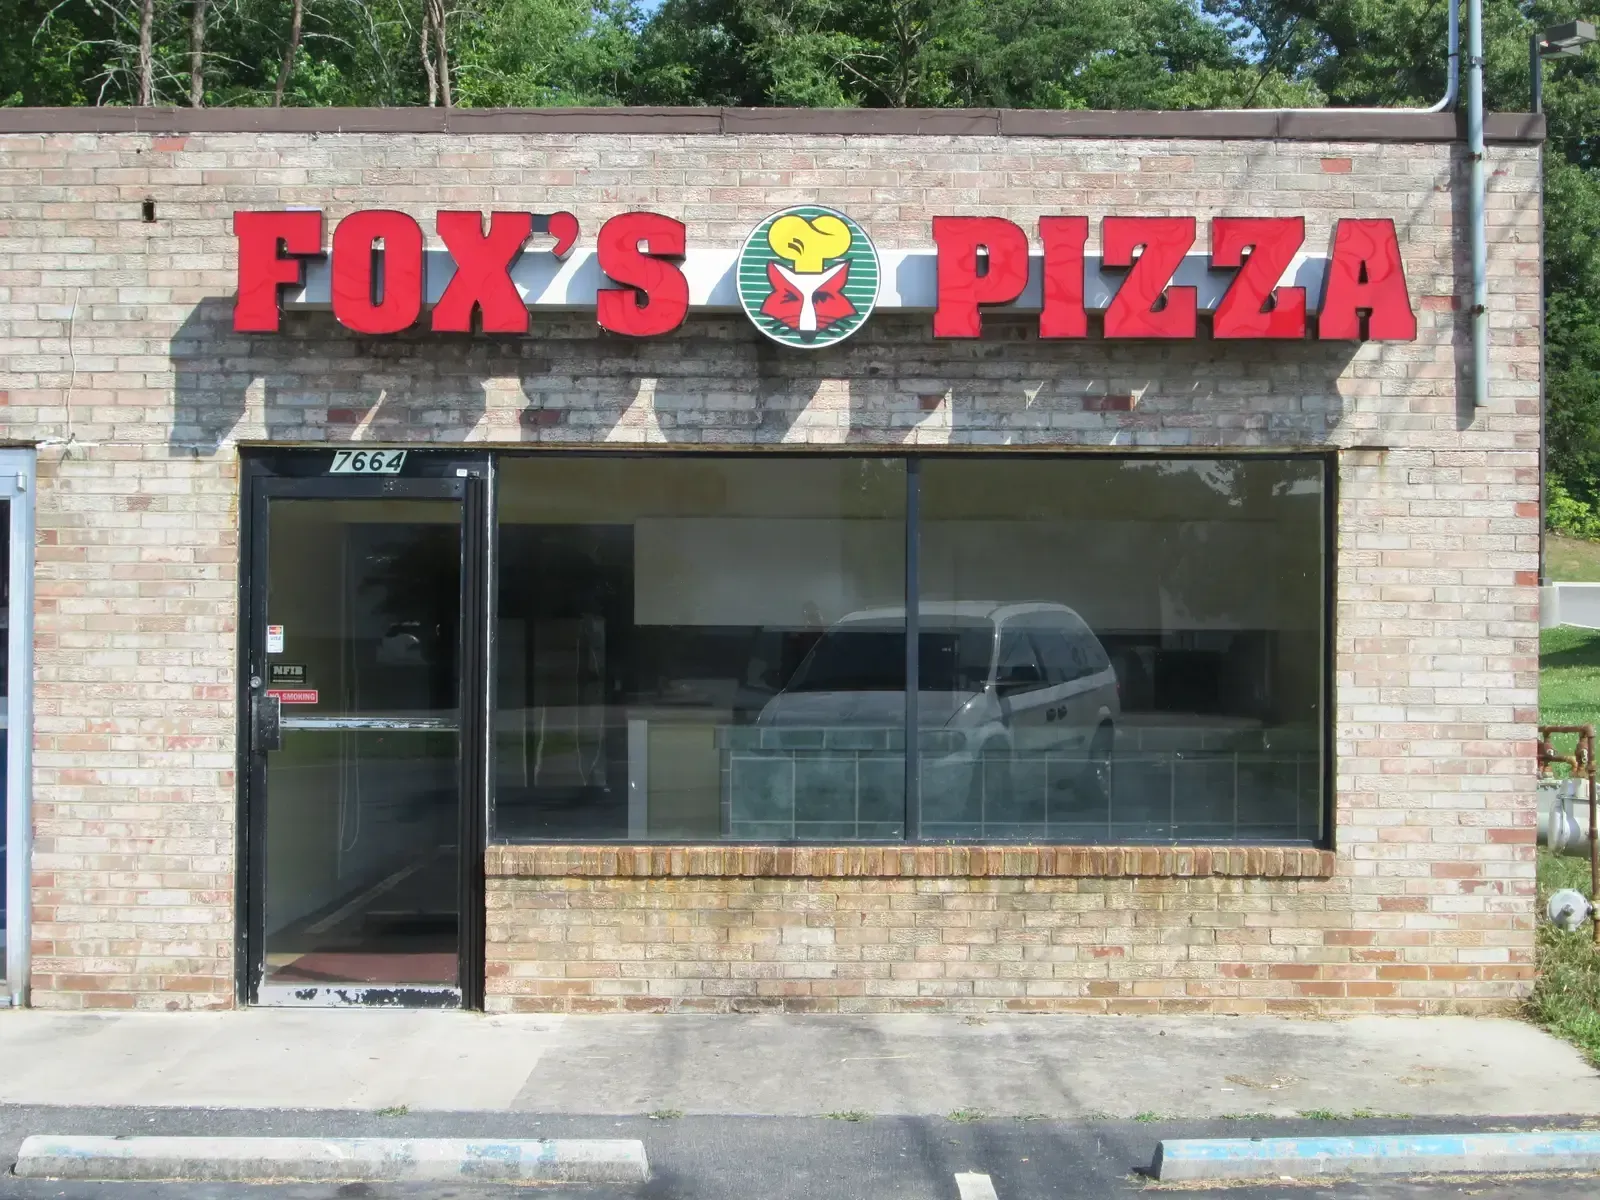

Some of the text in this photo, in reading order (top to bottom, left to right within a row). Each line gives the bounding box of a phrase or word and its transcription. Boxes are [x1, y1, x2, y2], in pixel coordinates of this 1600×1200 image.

[233, 209, 1418, 341] FOX'S PIZZA
[333, 451, 405, 472] 7664
[273, 665, 303, 675] NFIB
[282, 692, 316, 701] SMOKING
